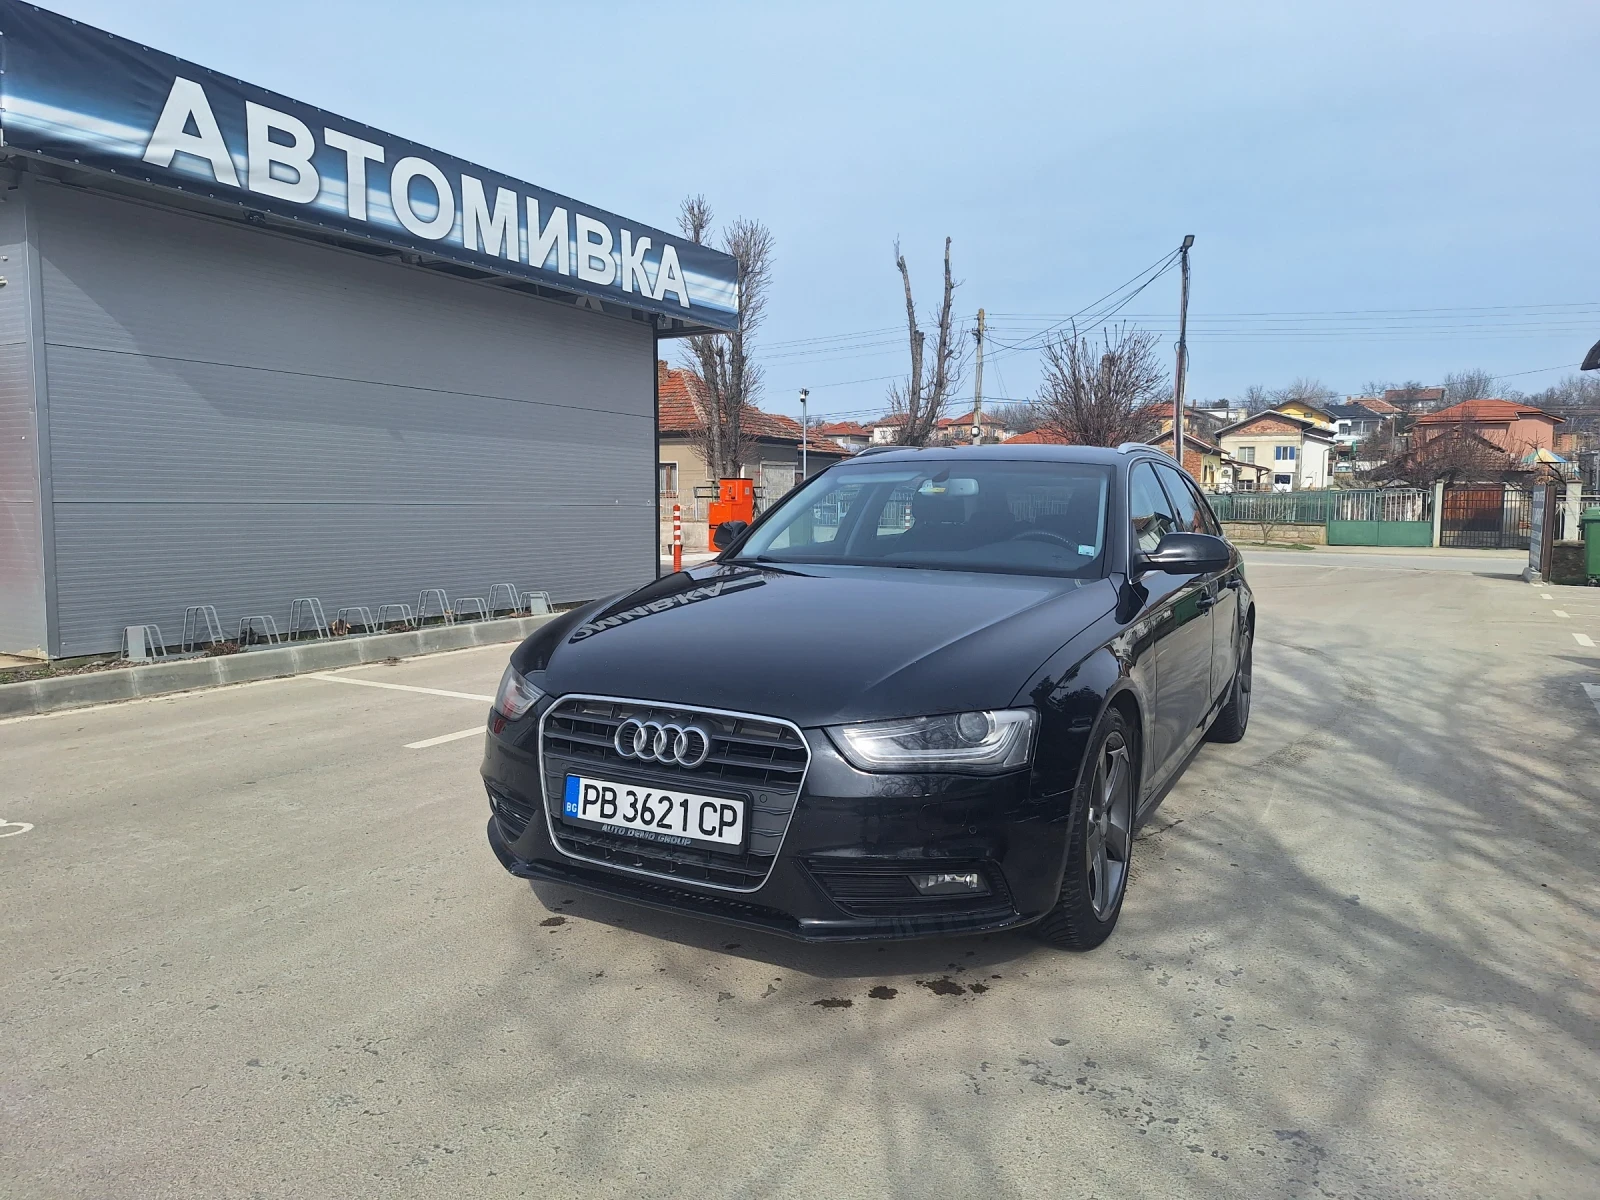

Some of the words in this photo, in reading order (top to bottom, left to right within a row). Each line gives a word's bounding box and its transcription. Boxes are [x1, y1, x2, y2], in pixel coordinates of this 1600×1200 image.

[142, 76, 690, 307] АВТОМИВКА
[566, 802, 577, 813] BG
[623, 790, 689, 832] 3621
[601, 824, 626, 835] AUTO
